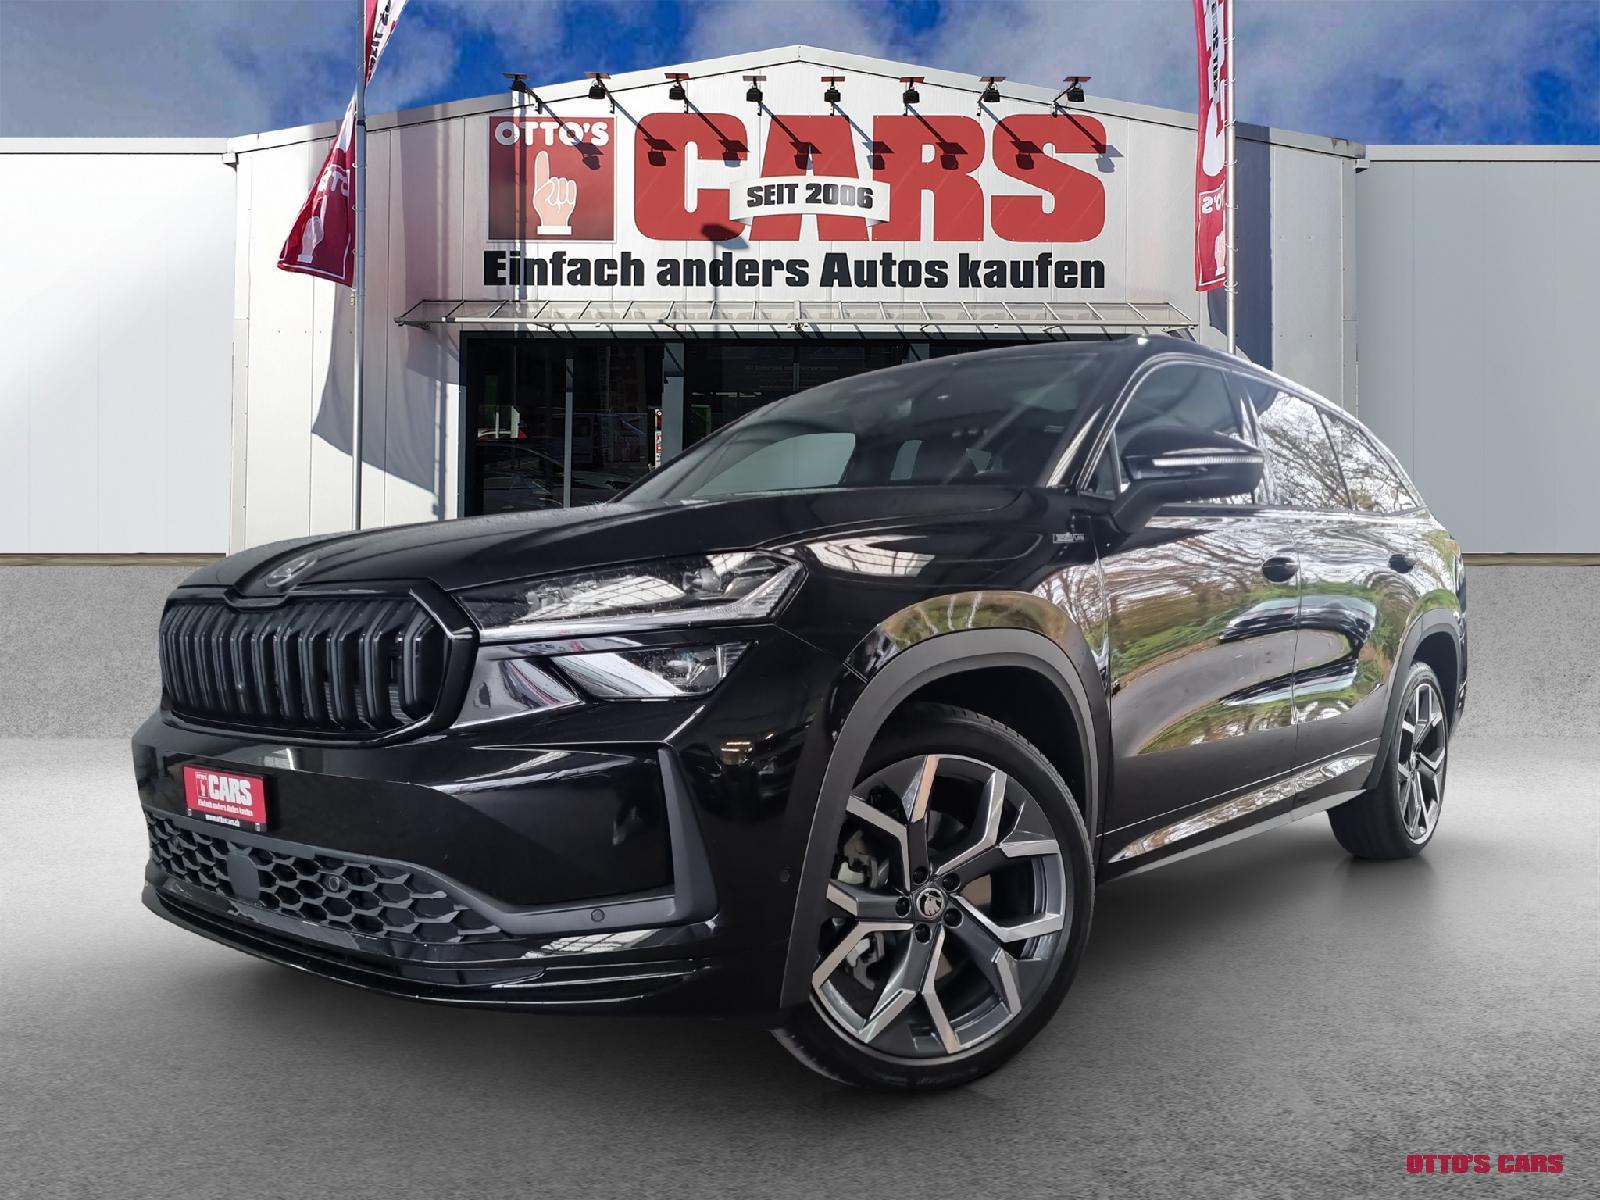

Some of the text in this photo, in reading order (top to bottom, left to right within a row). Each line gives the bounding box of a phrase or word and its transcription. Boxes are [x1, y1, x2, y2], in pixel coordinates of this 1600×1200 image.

[495, 122, 609, 146] OTTO'S
[634, 112, 1107, 243] CARS
[747, 183, 874, 209] SEIT 2006
[484, 251, 1105, 288] Einfach anders Autos kaufen
[208, 774, 253, 806] CARS
